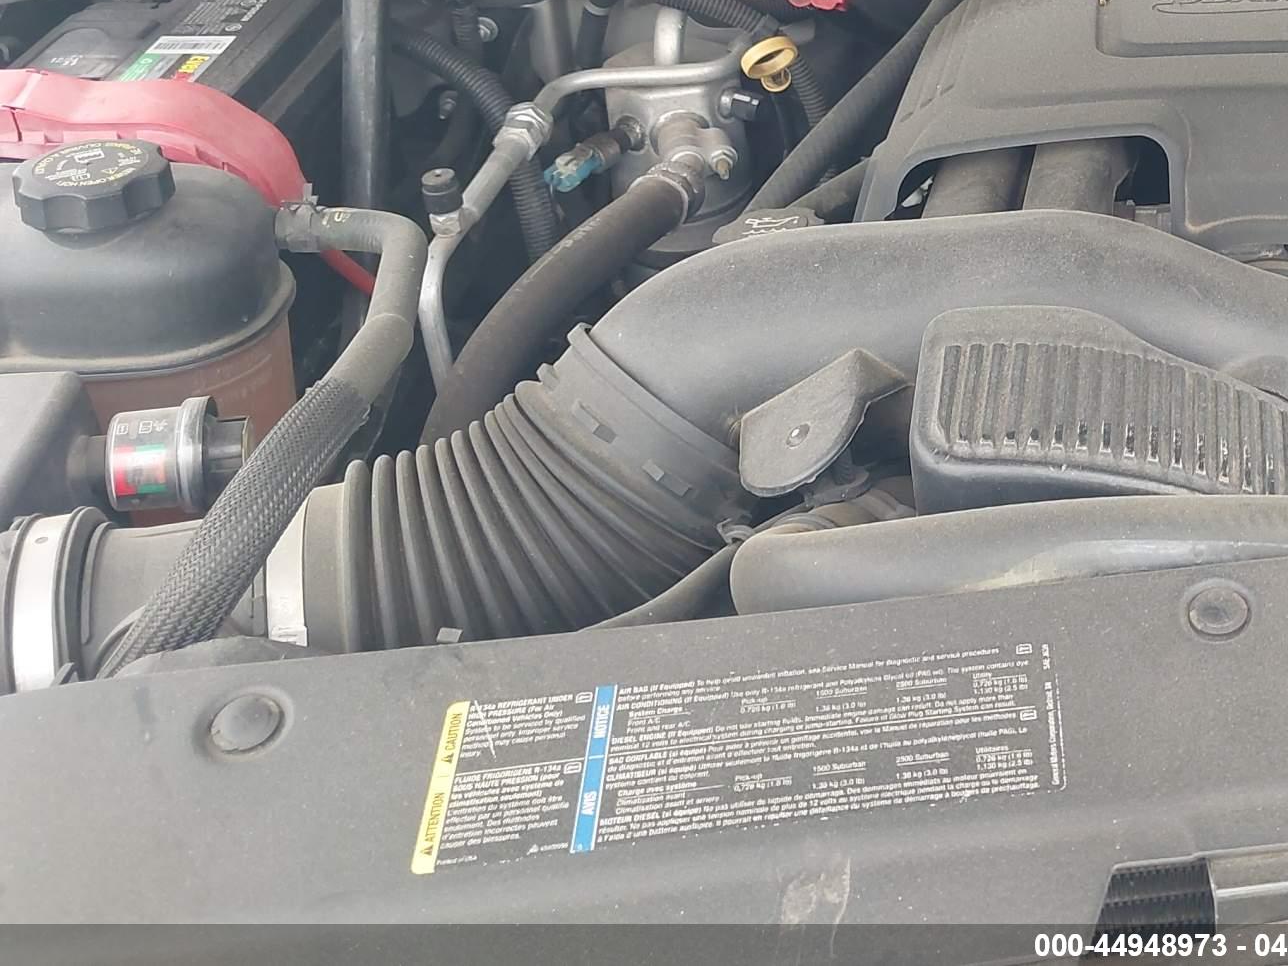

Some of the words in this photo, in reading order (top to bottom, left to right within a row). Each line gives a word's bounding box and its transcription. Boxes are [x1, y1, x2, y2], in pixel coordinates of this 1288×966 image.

[443, 712, 463, 751] CAUTION
[592, 703, 610, 739] NOTICE
[423, 791, 446, 843] ATTENTION
[580, 790, 597, 816] AVIS
